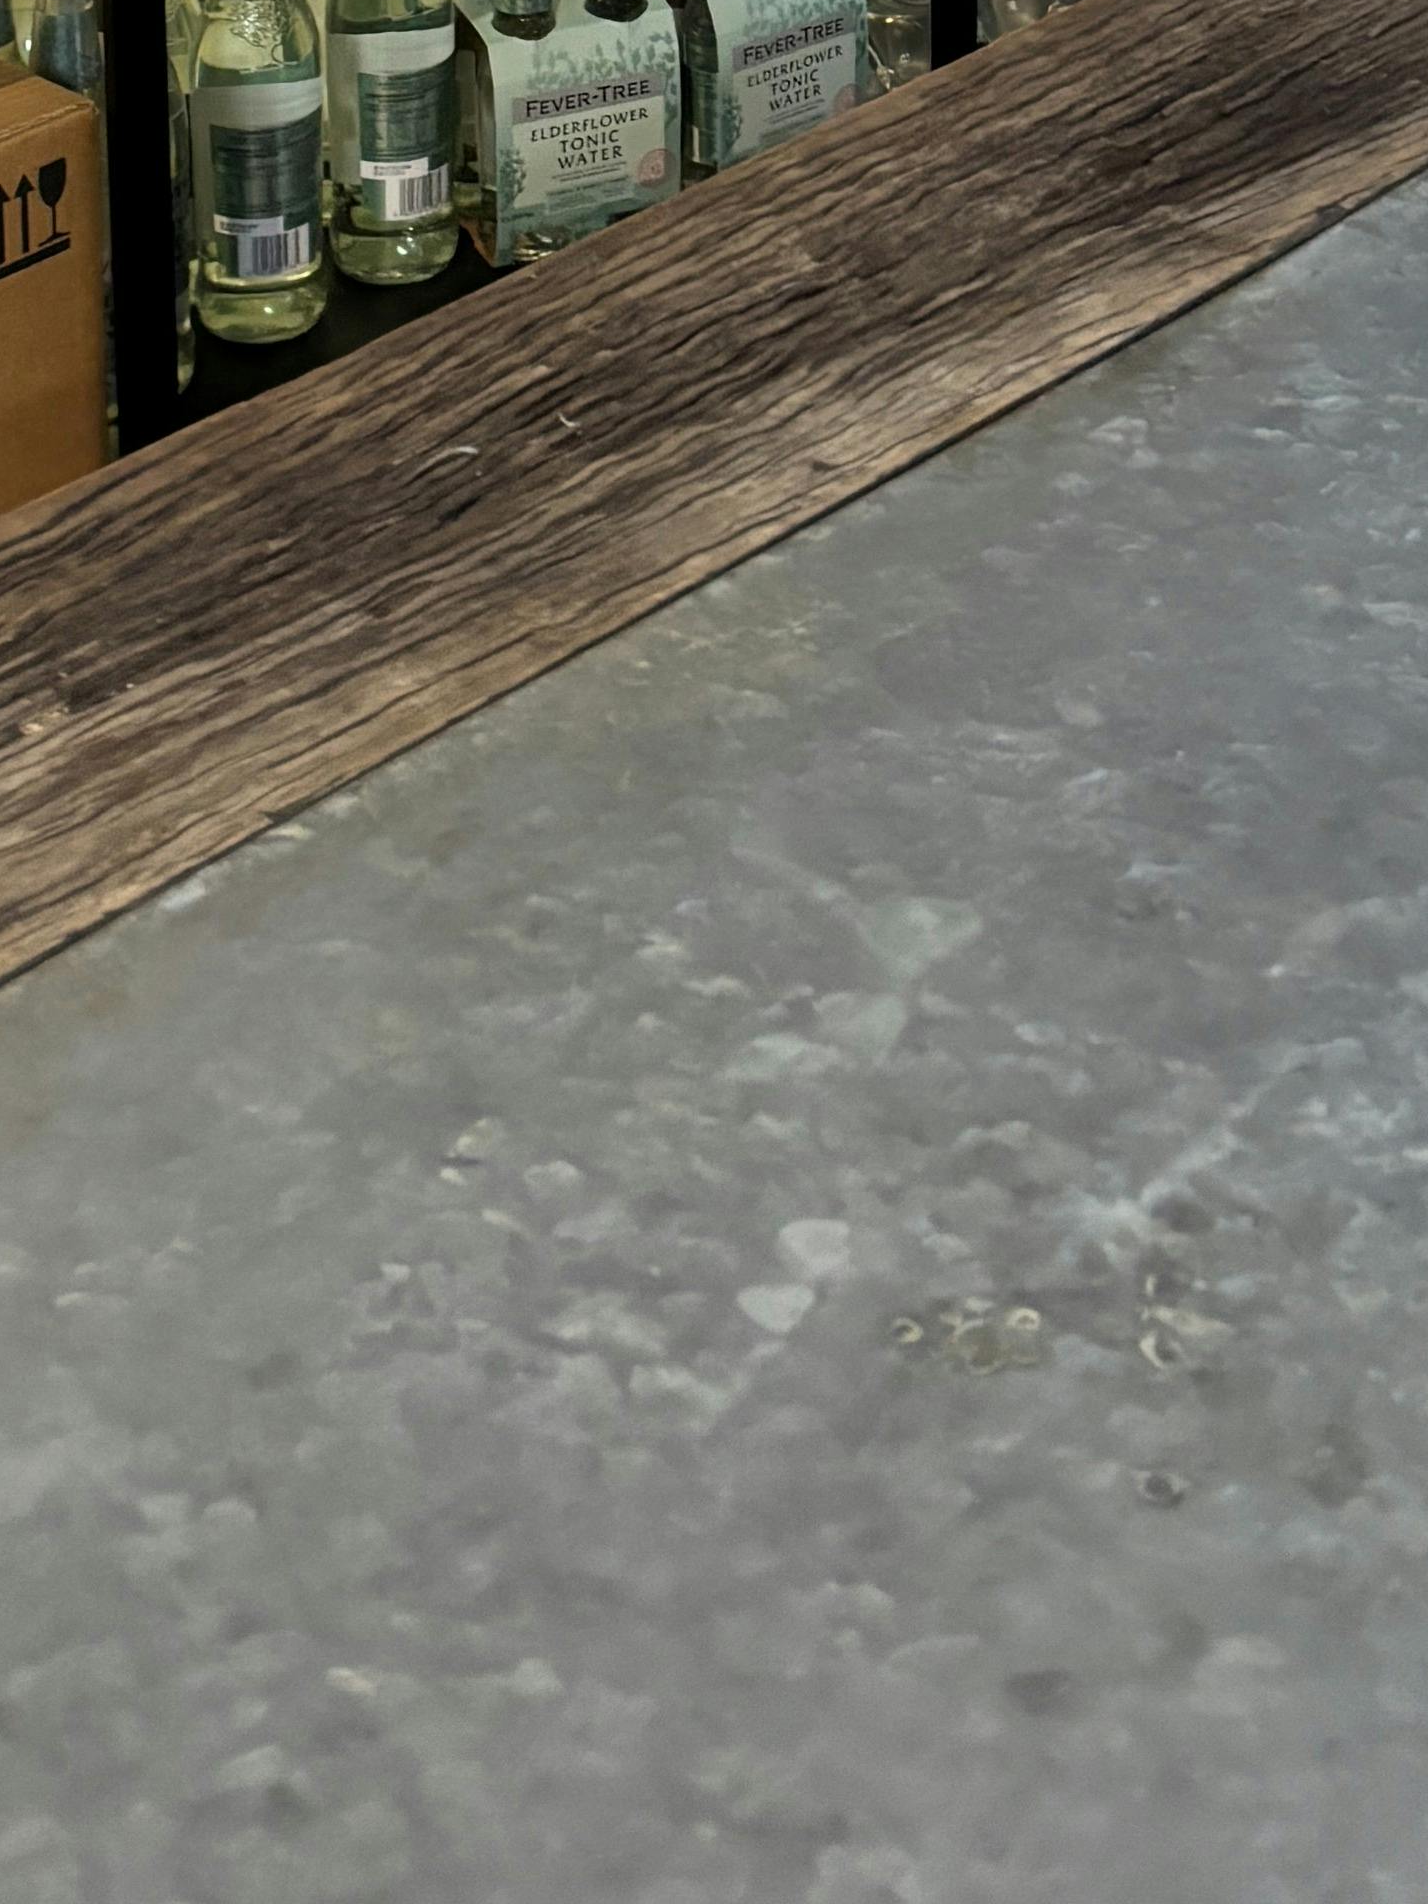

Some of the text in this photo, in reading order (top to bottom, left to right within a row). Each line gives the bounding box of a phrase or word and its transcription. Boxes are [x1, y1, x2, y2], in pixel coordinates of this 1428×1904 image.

[743, 18, 844, 65] FEVER-TREE
[747, 45, 843, 87] ELDERFLOWER
[769, 84, 821, 111] WATER
[771, 69, 819, 95] TONIC
[526, 80, 651, 117] FEVER-TREE
[530, 107, 649, 142] ELDERFLOWER
[560, 129, 619, 153] TONIC
[557, 145, 623, 169] WATER
